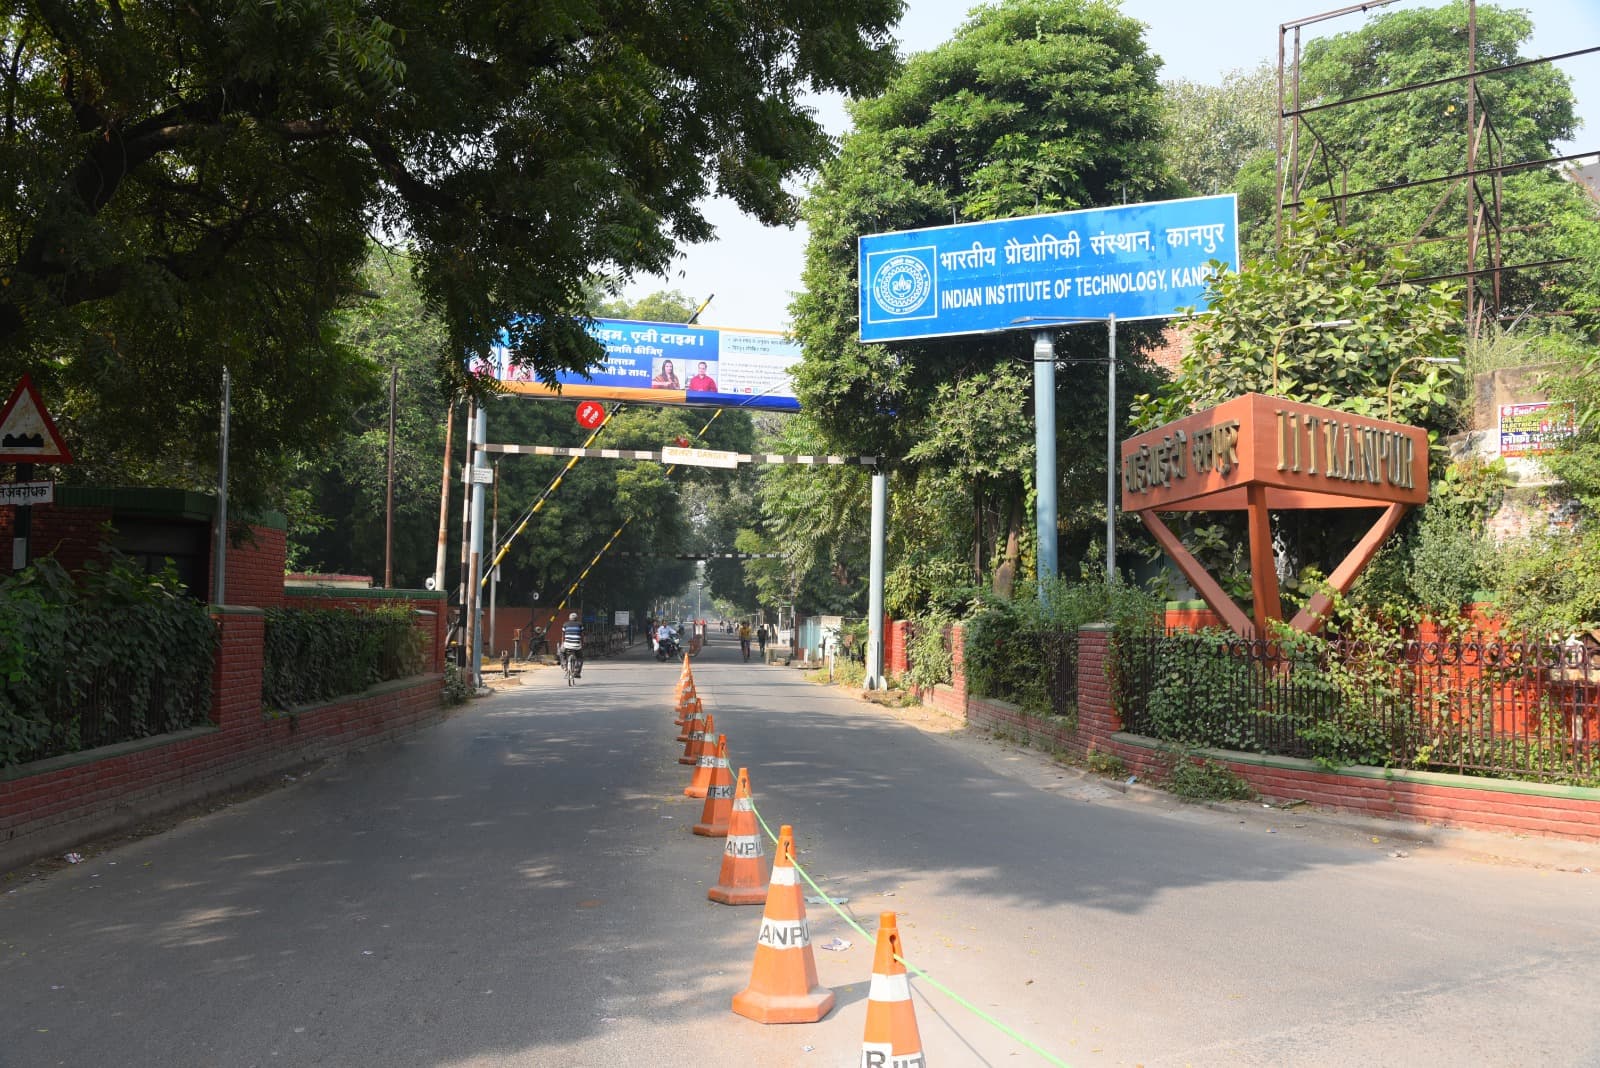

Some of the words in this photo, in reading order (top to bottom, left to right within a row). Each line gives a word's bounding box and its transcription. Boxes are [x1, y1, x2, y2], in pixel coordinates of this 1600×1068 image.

[940, 241, 996, 271] भारतीय
[1005, 230, 1080, 264] प्रौद्योगिकी
[1166, 223, 1225, 253] कानपुर
[942, 287, 983, 310] INDIAN
[985, 280, 1051, 306] INSTITUTE
[1054, 278, 1072, 299] OF
[1075, 269, 1168, 297] TECHNOLOGY,
[1191, 419, 1240, 475] कानपुर
[1323, 418, 1415, 489] KANPUR
